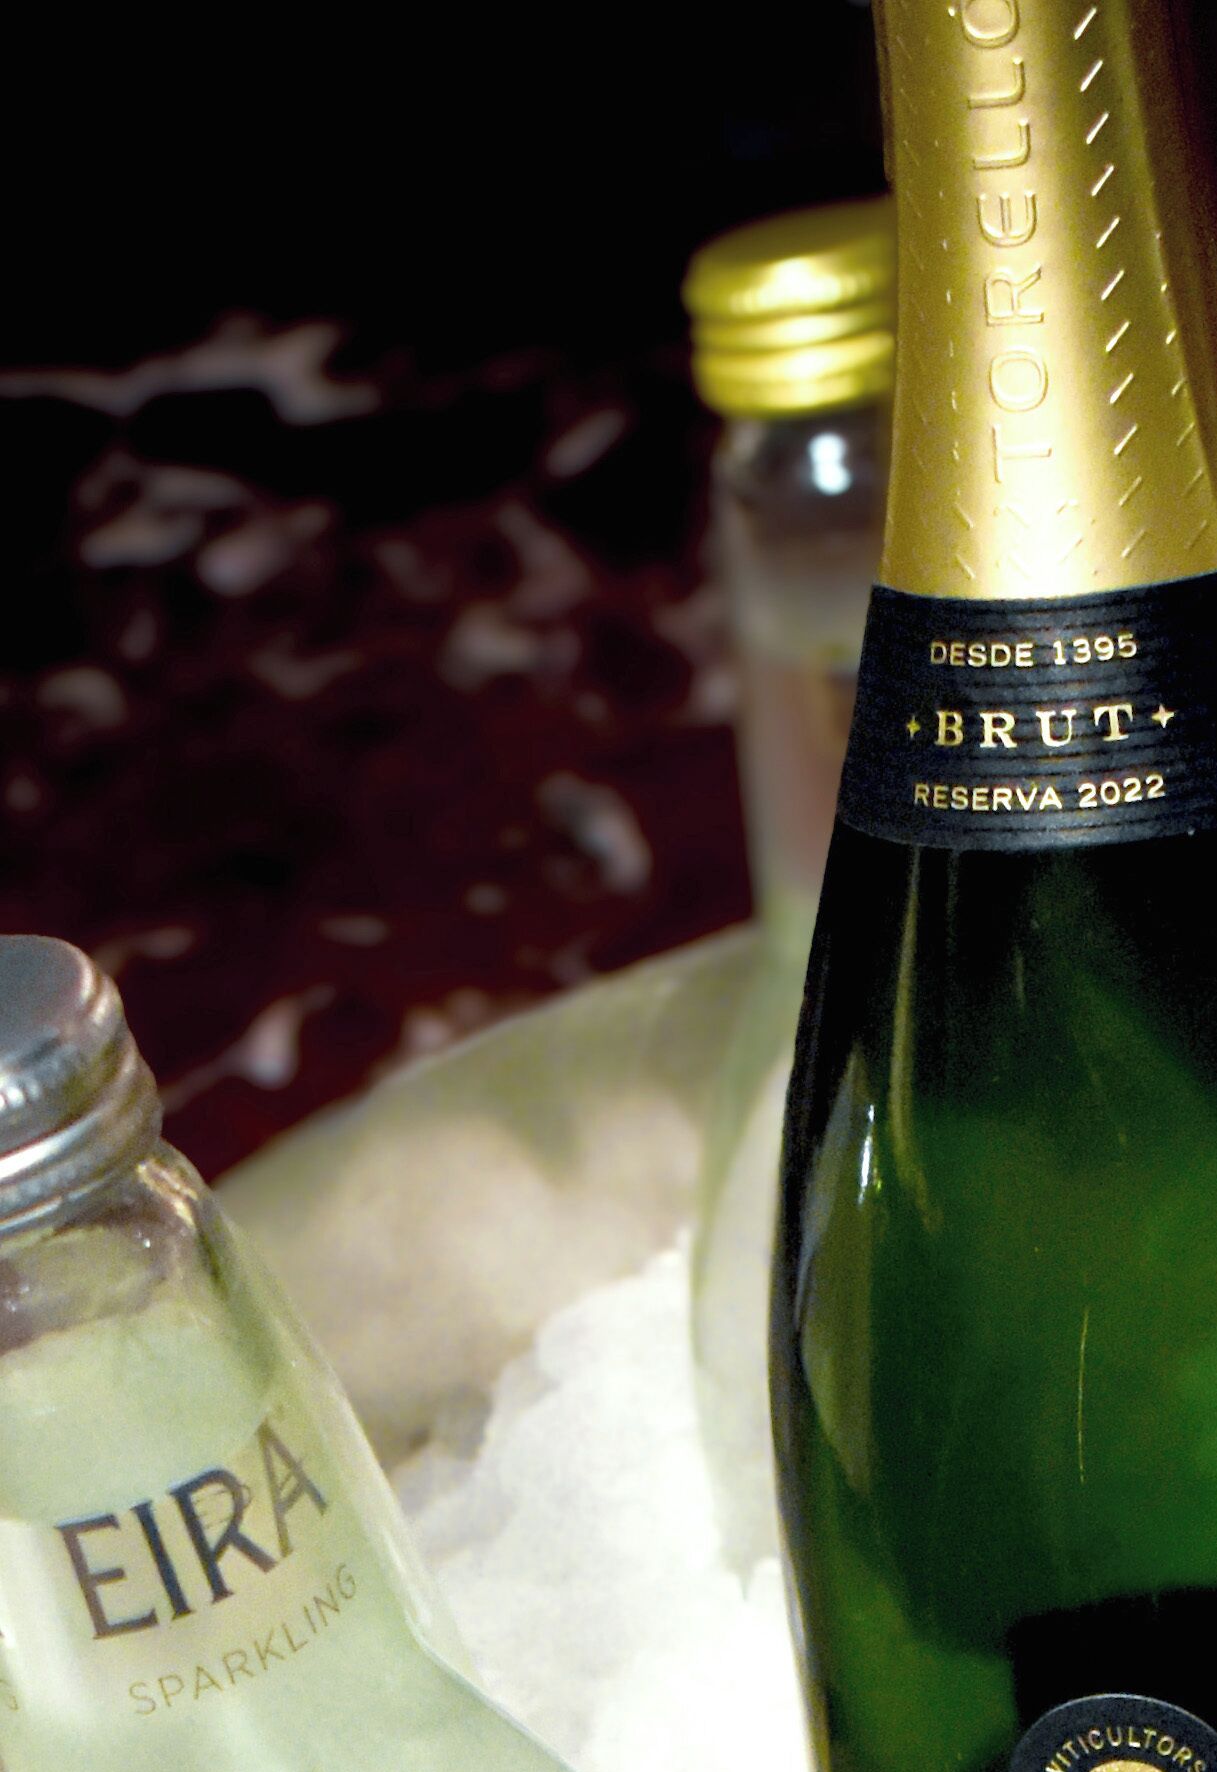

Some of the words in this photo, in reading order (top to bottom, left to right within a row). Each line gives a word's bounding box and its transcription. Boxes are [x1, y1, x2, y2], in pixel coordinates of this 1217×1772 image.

[930, 639, 1034, 668] DESDE
[1052, 633, 1138, 666] 1395
[933, 703, 1136, 748] BRUT
[914, 781, 1063, 813] RESERVA
[1078, 774, 1167, 808] 2022
[54, 1416, 329, 1640] EIRA
[128, 1562, 360, 1717] SPARKLING
